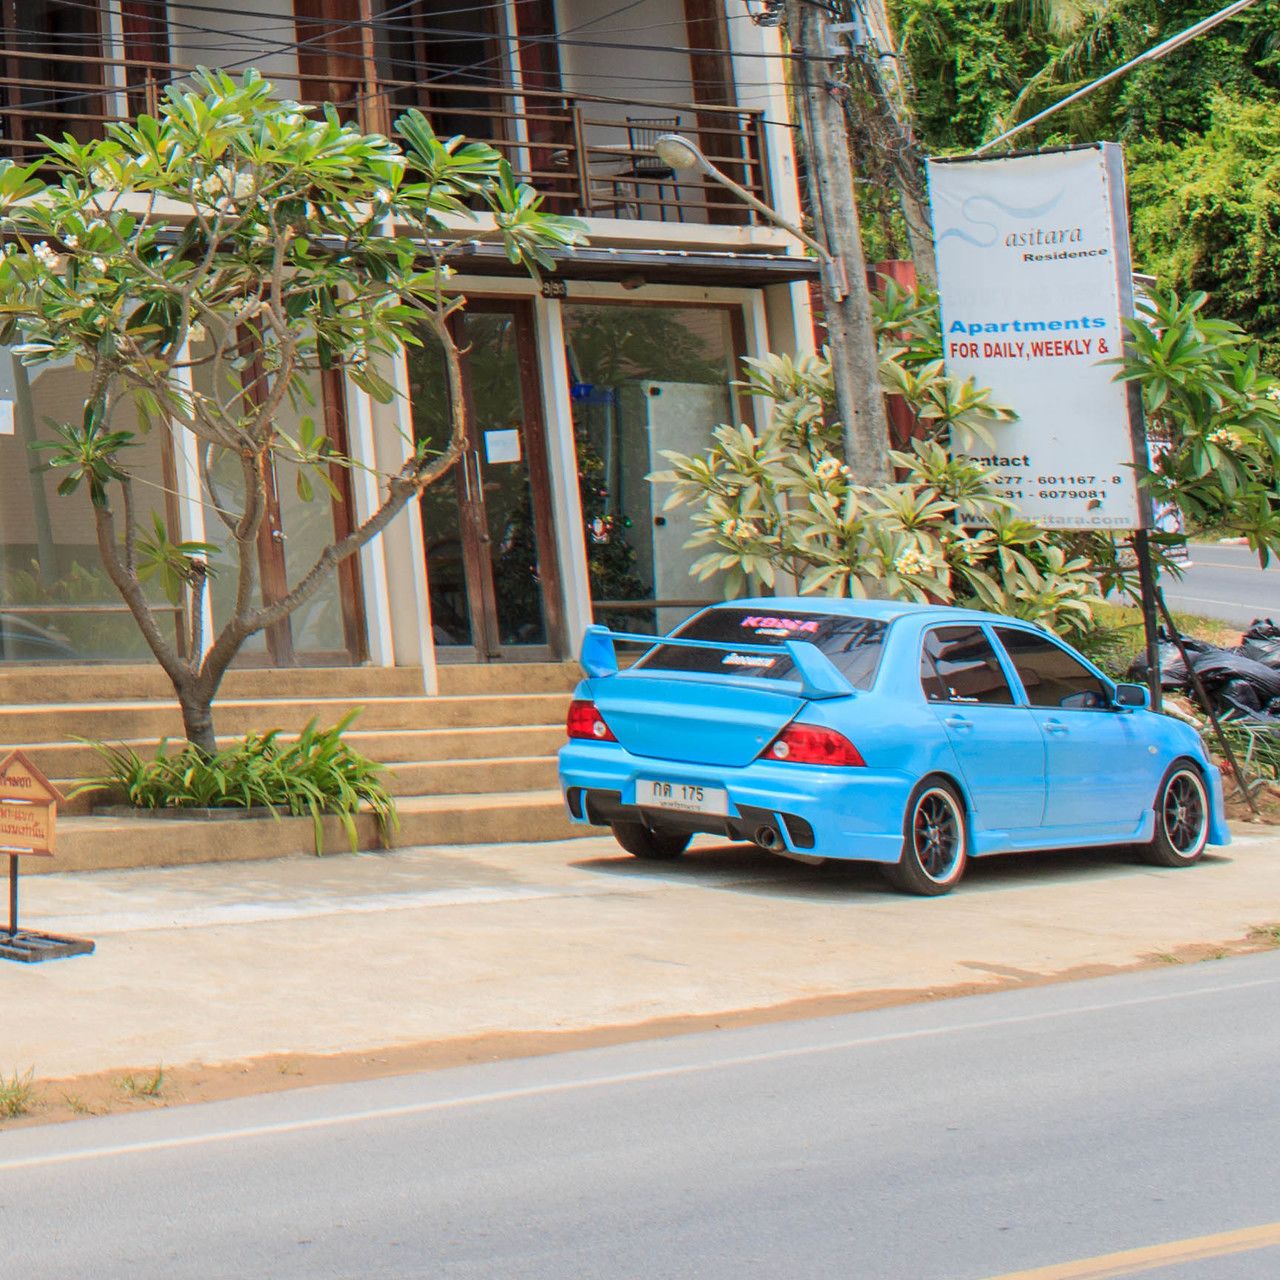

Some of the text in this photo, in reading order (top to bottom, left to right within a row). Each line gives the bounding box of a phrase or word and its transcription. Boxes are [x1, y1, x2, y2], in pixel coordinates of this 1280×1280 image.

[1004, 226, 1082, 247] asitara
[1023, 248, 1108, 262] Residence
[949, 316, 1107, 336] Apartments
[950, 342, 979, 359] FOR
[1098, 337, 1109, 354] &
[956, 453, 1030, 467] ntact
[1038, 475, 1097, 485] 601167
[1111, 475, 1122, 485] 8
[1039, 490, 1108, 499] 6079081
[681, 785, 704, 802] 175
